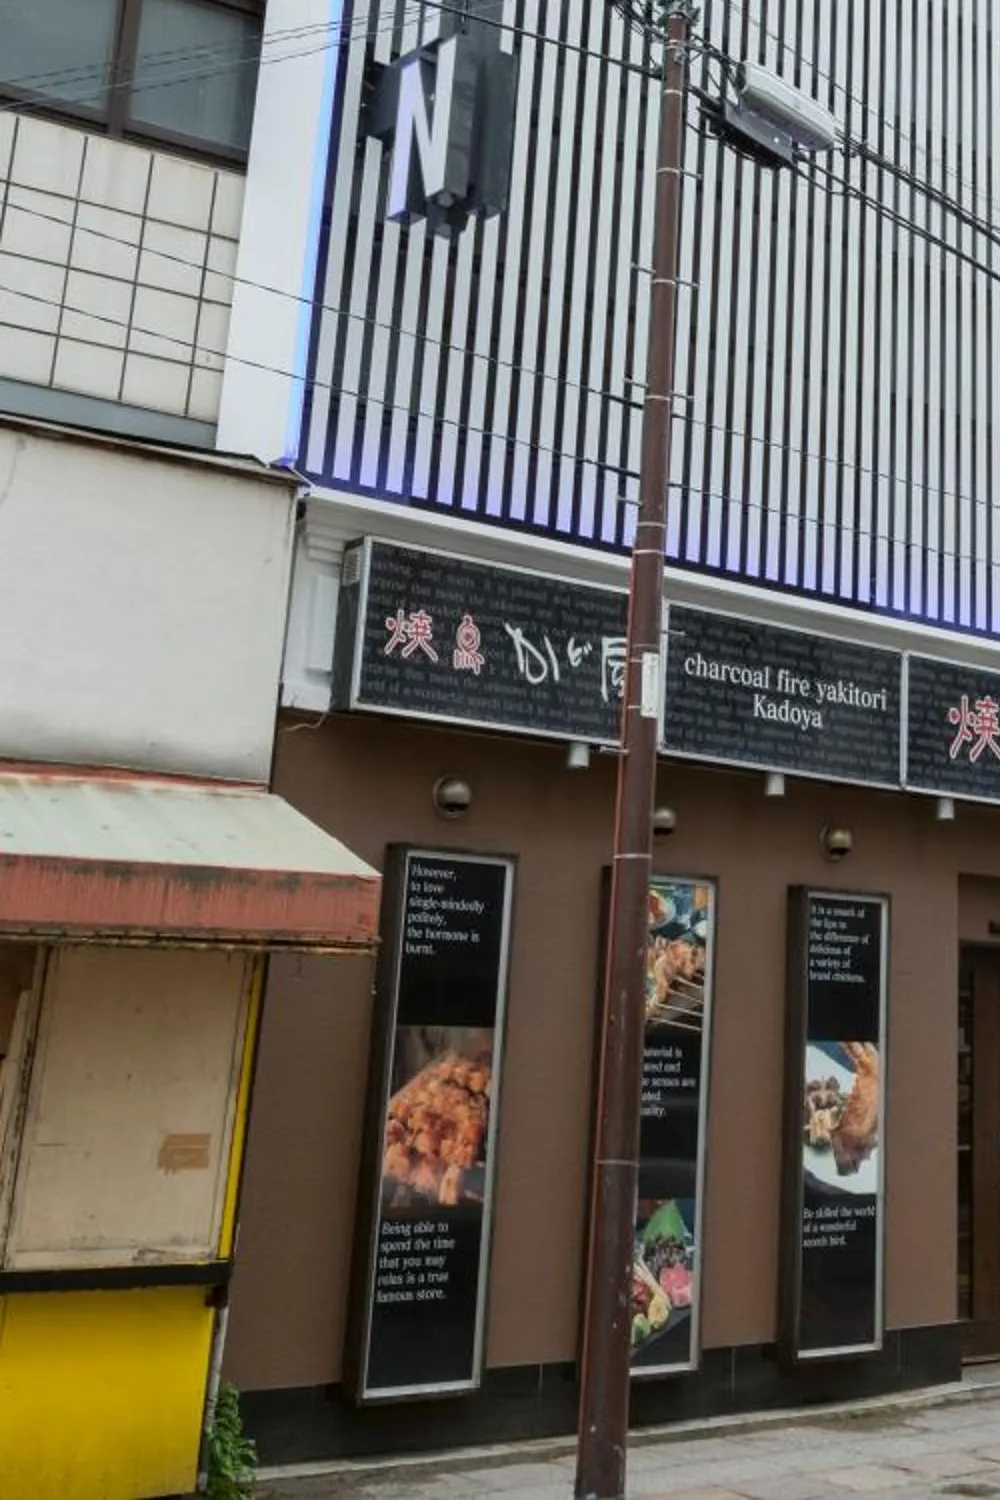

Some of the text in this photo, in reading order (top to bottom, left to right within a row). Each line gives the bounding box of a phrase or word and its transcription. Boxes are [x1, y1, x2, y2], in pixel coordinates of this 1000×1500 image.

[684, 652, 770, 690] charcoal
[776, 667, 811, 697] fire
[815, 680, 888, 712] yakitori
[752, 692, 824, 731] Kadoya
[409, 863, 457, 882] However,
